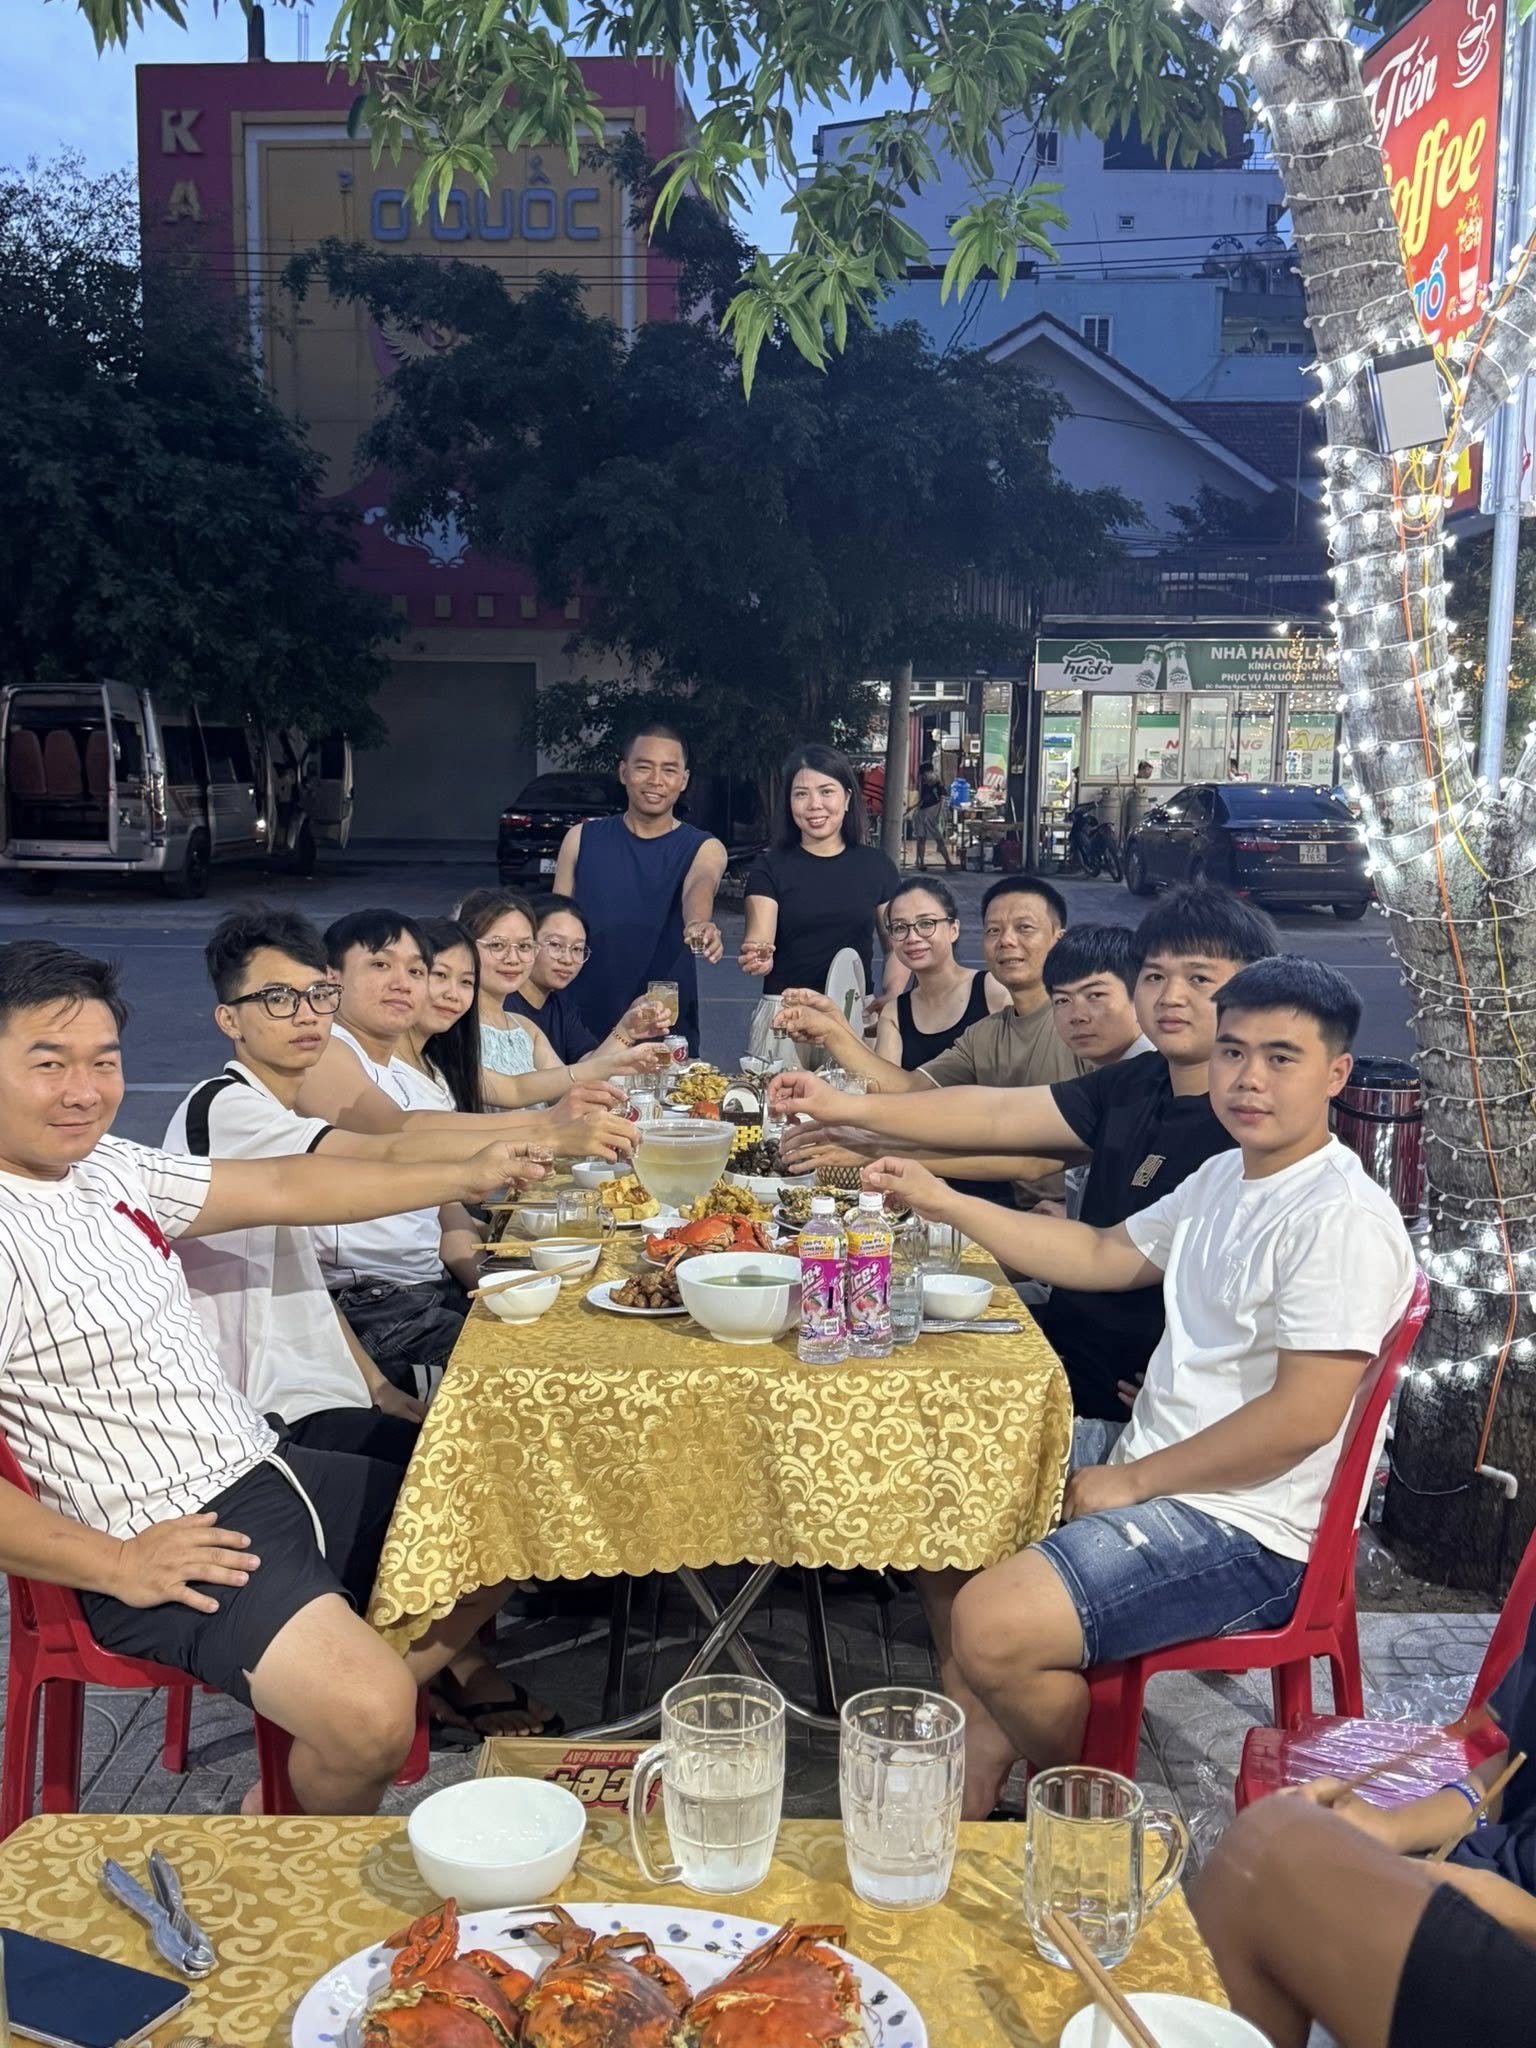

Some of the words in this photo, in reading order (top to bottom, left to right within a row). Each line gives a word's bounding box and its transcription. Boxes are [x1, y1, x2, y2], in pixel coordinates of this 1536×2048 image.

[1370, 35, 1438, 149] Tiến
[1383, 117, 1486, 258] offee
[1211, 644, 1248, 660] NHÀ
[1289, 729, 1335, 751] ÂM
[555, 1768, 634, 1803] ce+
